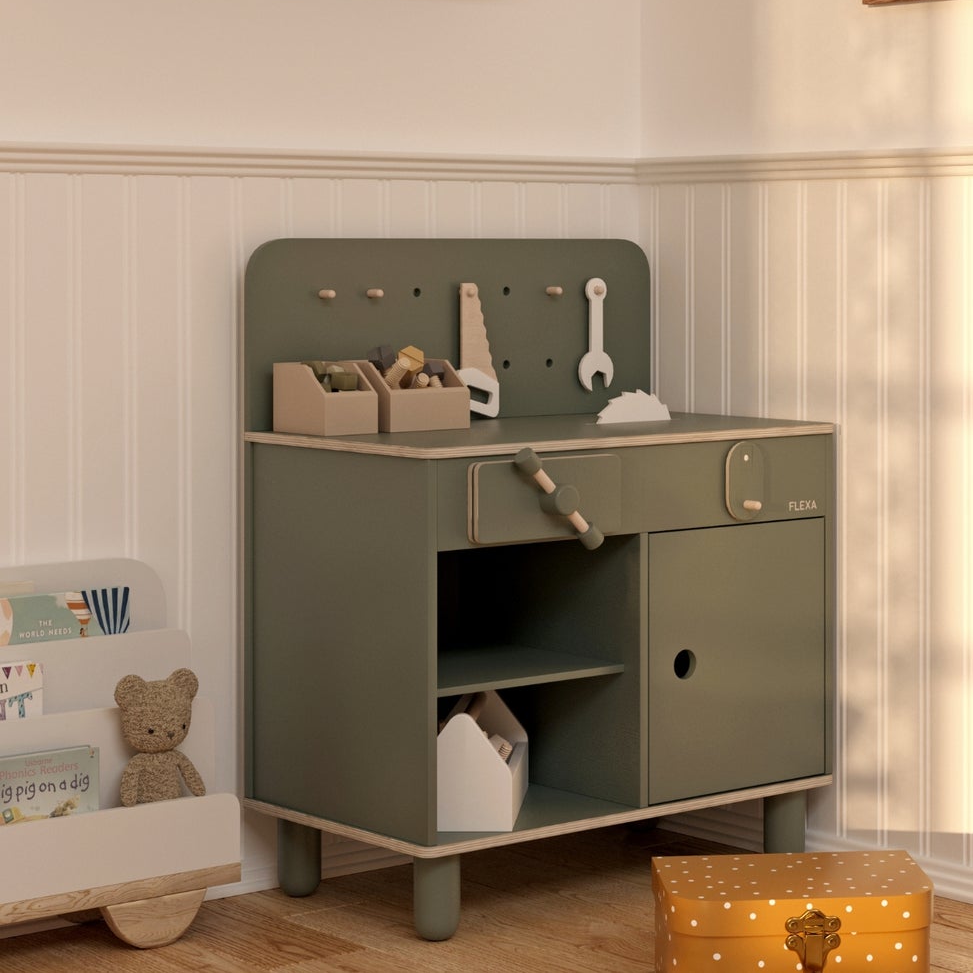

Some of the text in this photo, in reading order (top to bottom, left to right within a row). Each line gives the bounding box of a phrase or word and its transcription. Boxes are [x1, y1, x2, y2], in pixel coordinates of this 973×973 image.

[789, 500, 817, 511] FLEXA
[39, 619, 53, 627] THE
[19, 627, 72, 638] WORLD NEEDS
[0, 763, 79, 779] Phonics Readers
[16, 781, 36, 802] pig
[39, 782, 56, 792] on
[59, 780, 67, 790] a
[70, 773, 90, 792] dig
